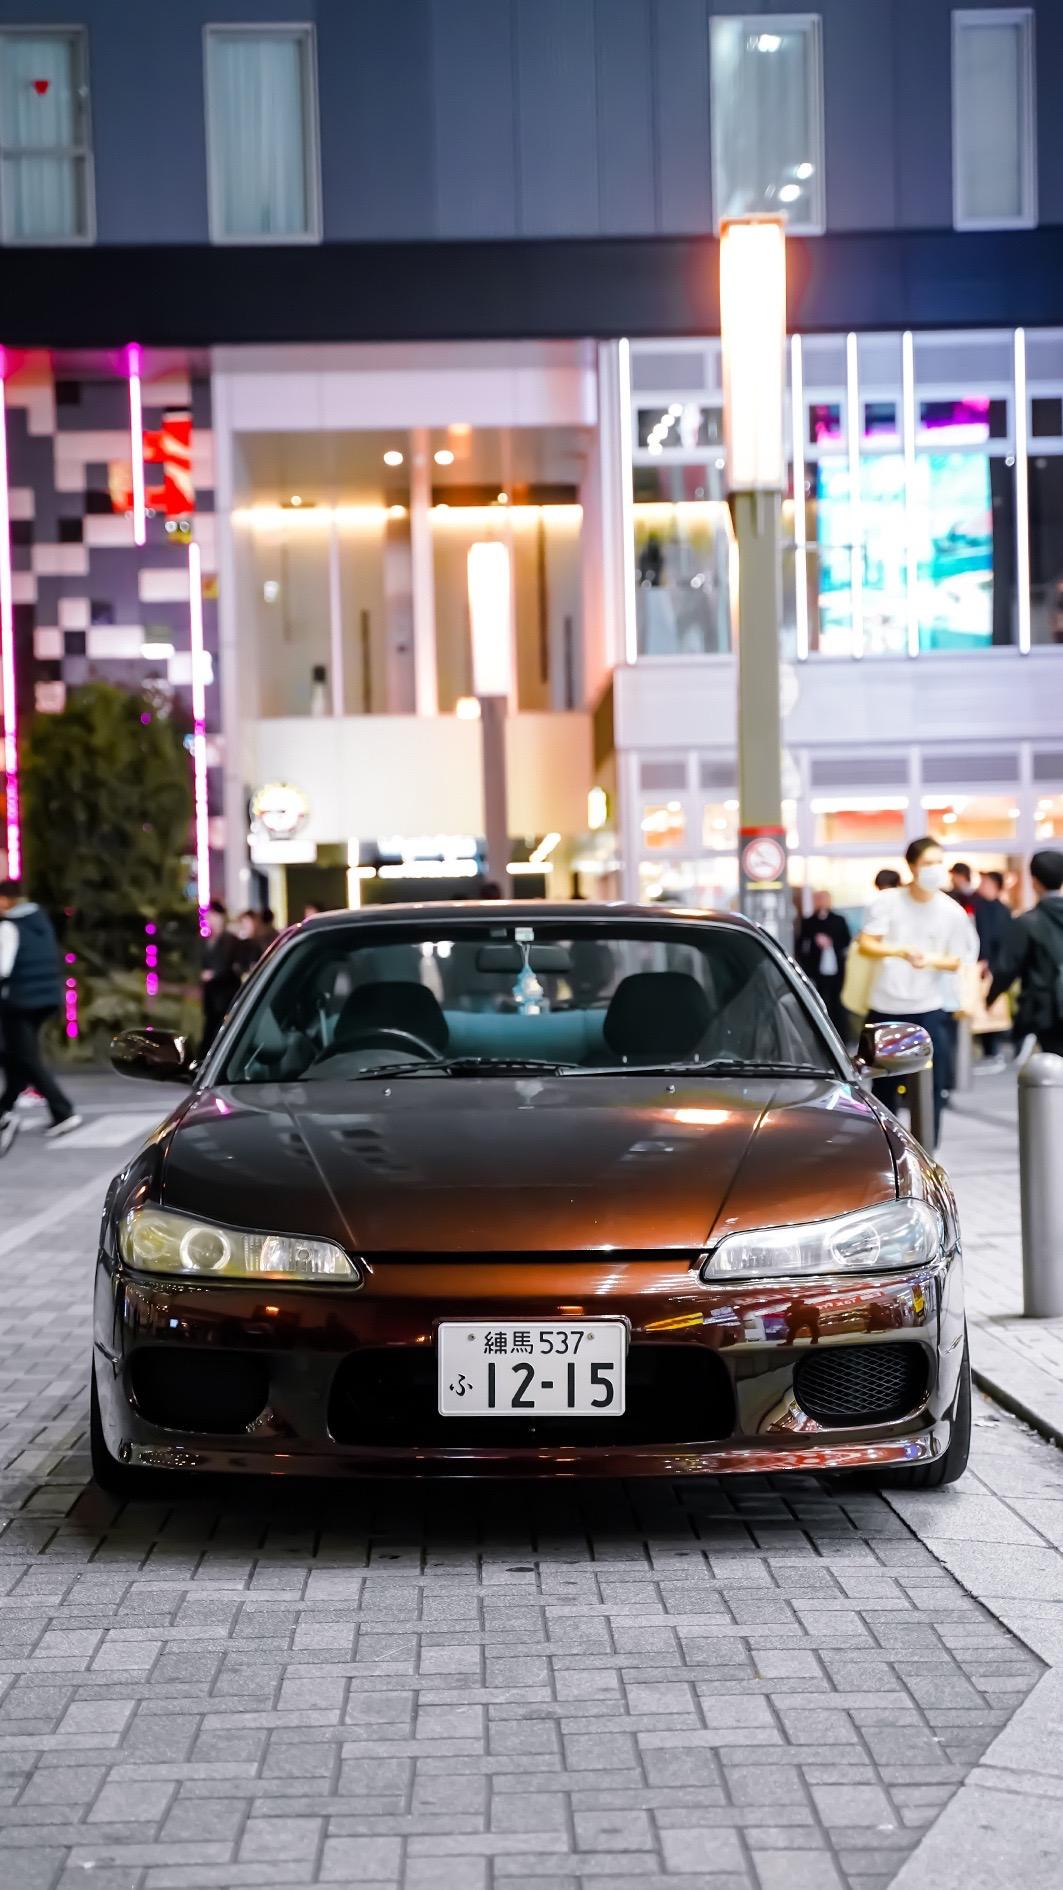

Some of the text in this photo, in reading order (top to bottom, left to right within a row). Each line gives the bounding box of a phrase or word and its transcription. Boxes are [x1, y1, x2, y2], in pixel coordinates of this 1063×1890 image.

[484, 1331, 585, 1355] 練馬 537
[449, 1362, 614, 1408] ふ 12-15
